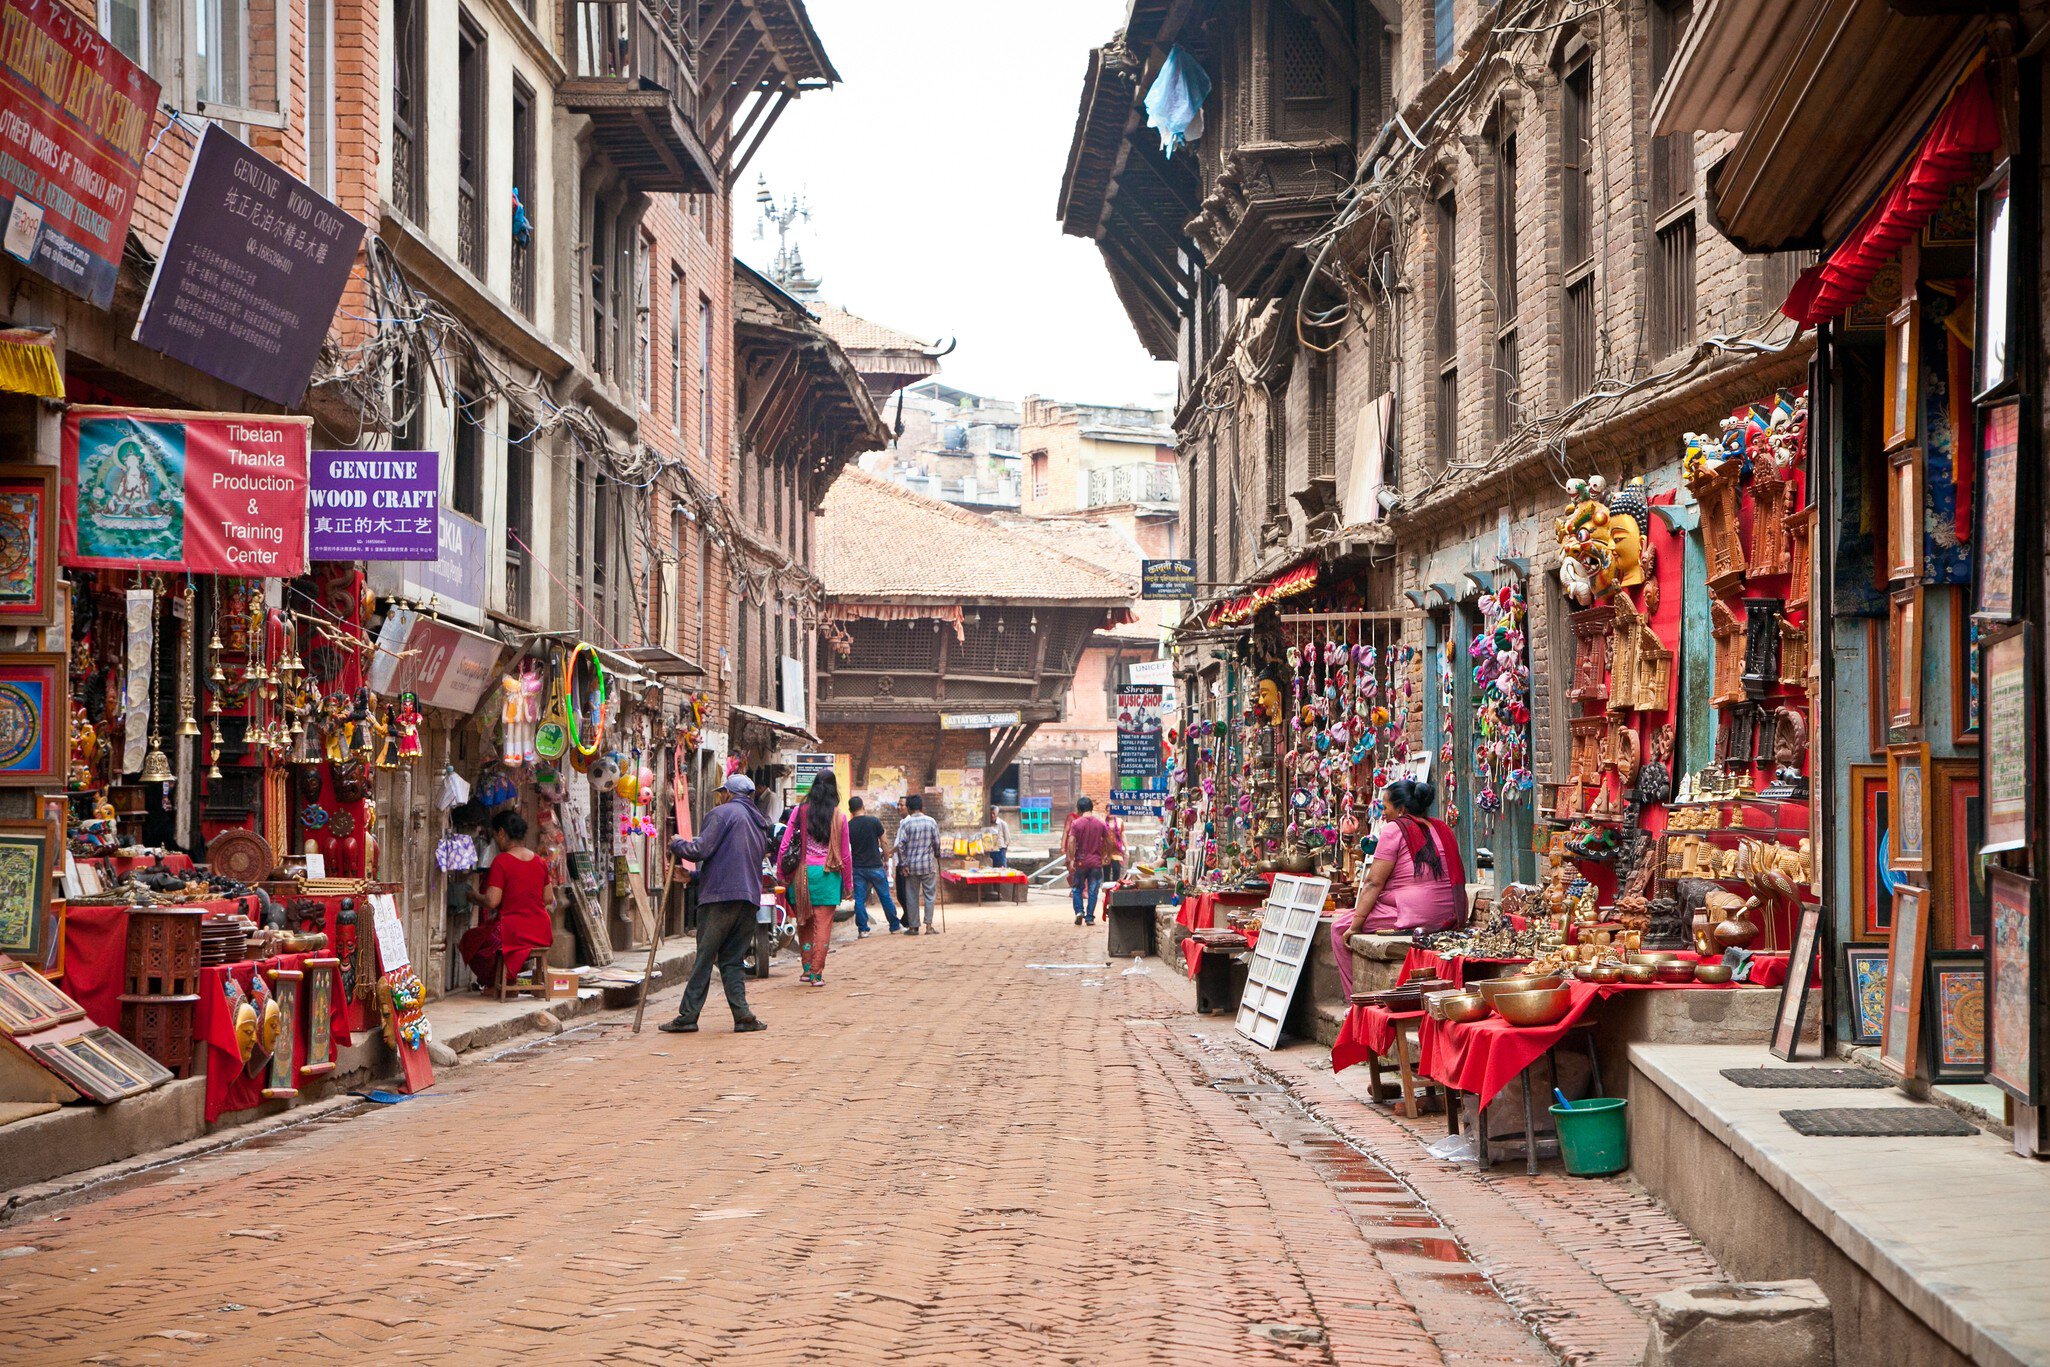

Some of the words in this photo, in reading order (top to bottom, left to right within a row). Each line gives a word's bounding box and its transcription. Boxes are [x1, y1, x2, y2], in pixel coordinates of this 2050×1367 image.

[0, 2, 73, 106] THANGKU
[64, 60, 104, 127] ART
[95, 83, 148, 166] SCHOOL
[0, 109, 30, 149] OTHER
[29, 127, 60, 169] WORKS
[60, 150, 72, 175] OF
[71, 157, 107, 200] THANGKU
[36, 177, 45, 201] &
[44, 181, 76, 221] NEWARI
[234, 157, 280, 199] GENUINE
[287, 188, 313, 220] WOOD
[314, 210, 345, 241] CRAFT
[223, 186, 329, 265] 纯正尼泊尔精品木雕
[226, 425, 283, 443] Tibetan
[228, 449, 285, 467] Thanka
[329, 461, 417, 479] GENUINE
[212, 472, 294, 491] Production
[247, 498, 259, 515] &
[310, 489, 368, 508] WOOD
[372, 490, 437, 508] CRAFT
[221, 521, 283, 544] Training
[313, 516, 432, 534] 真正的木工艺
[439, 516, 463, 555] OKIA
[226, 546, 278, 564] Center
[417, 644, 446, 683] LG
[1135, 662, 1167, 673] UNICEF
[1123, 685, 1155, 695] Shreya
[1118, 695, 1141, 707] MUSIC
[1142, 694, 1163, 707] SHOP
[989, 713, 1018, 724] SQUARE
[1114, 792, 1130, 800] TEA
[1139, 792, 1167, 800] SPICES
